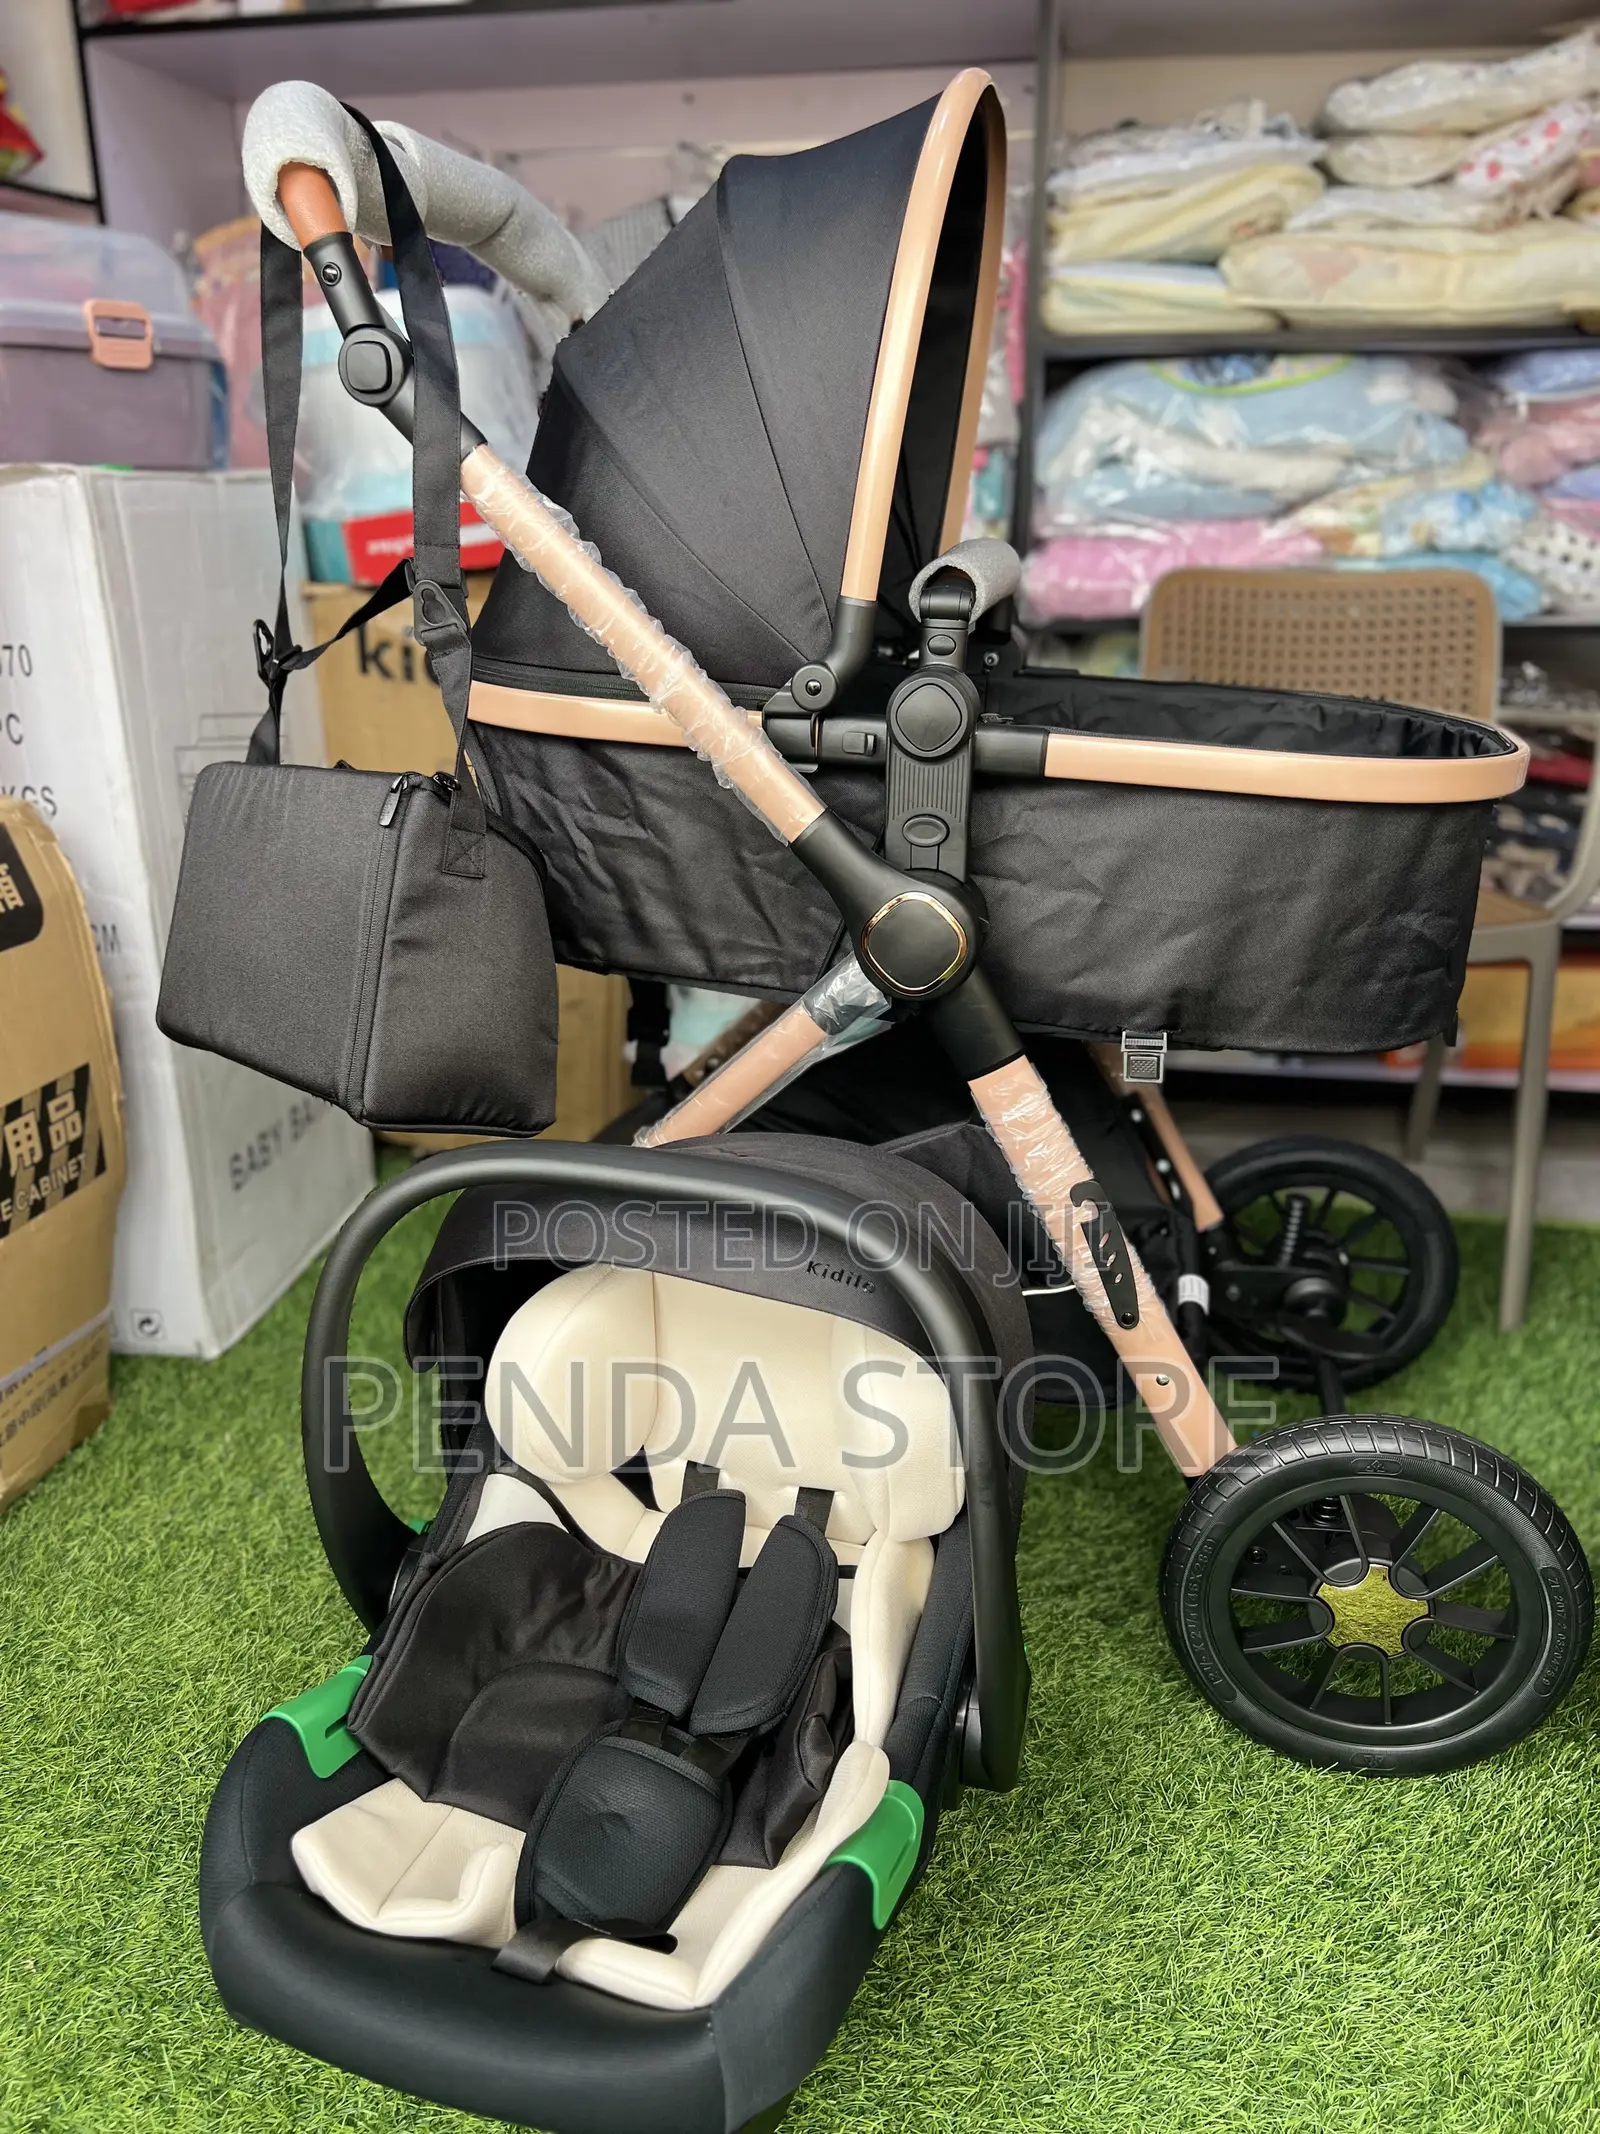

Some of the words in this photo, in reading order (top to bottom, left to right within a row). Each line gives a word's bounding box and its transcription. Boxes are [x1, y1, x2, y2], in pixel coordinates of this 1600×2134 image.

[0, 644, 33, 678] 70
[0, 713, 24, 746] C
[229, 1121, 284, 1192] BABY
[15, 1152, 86, 1212] CABINET
